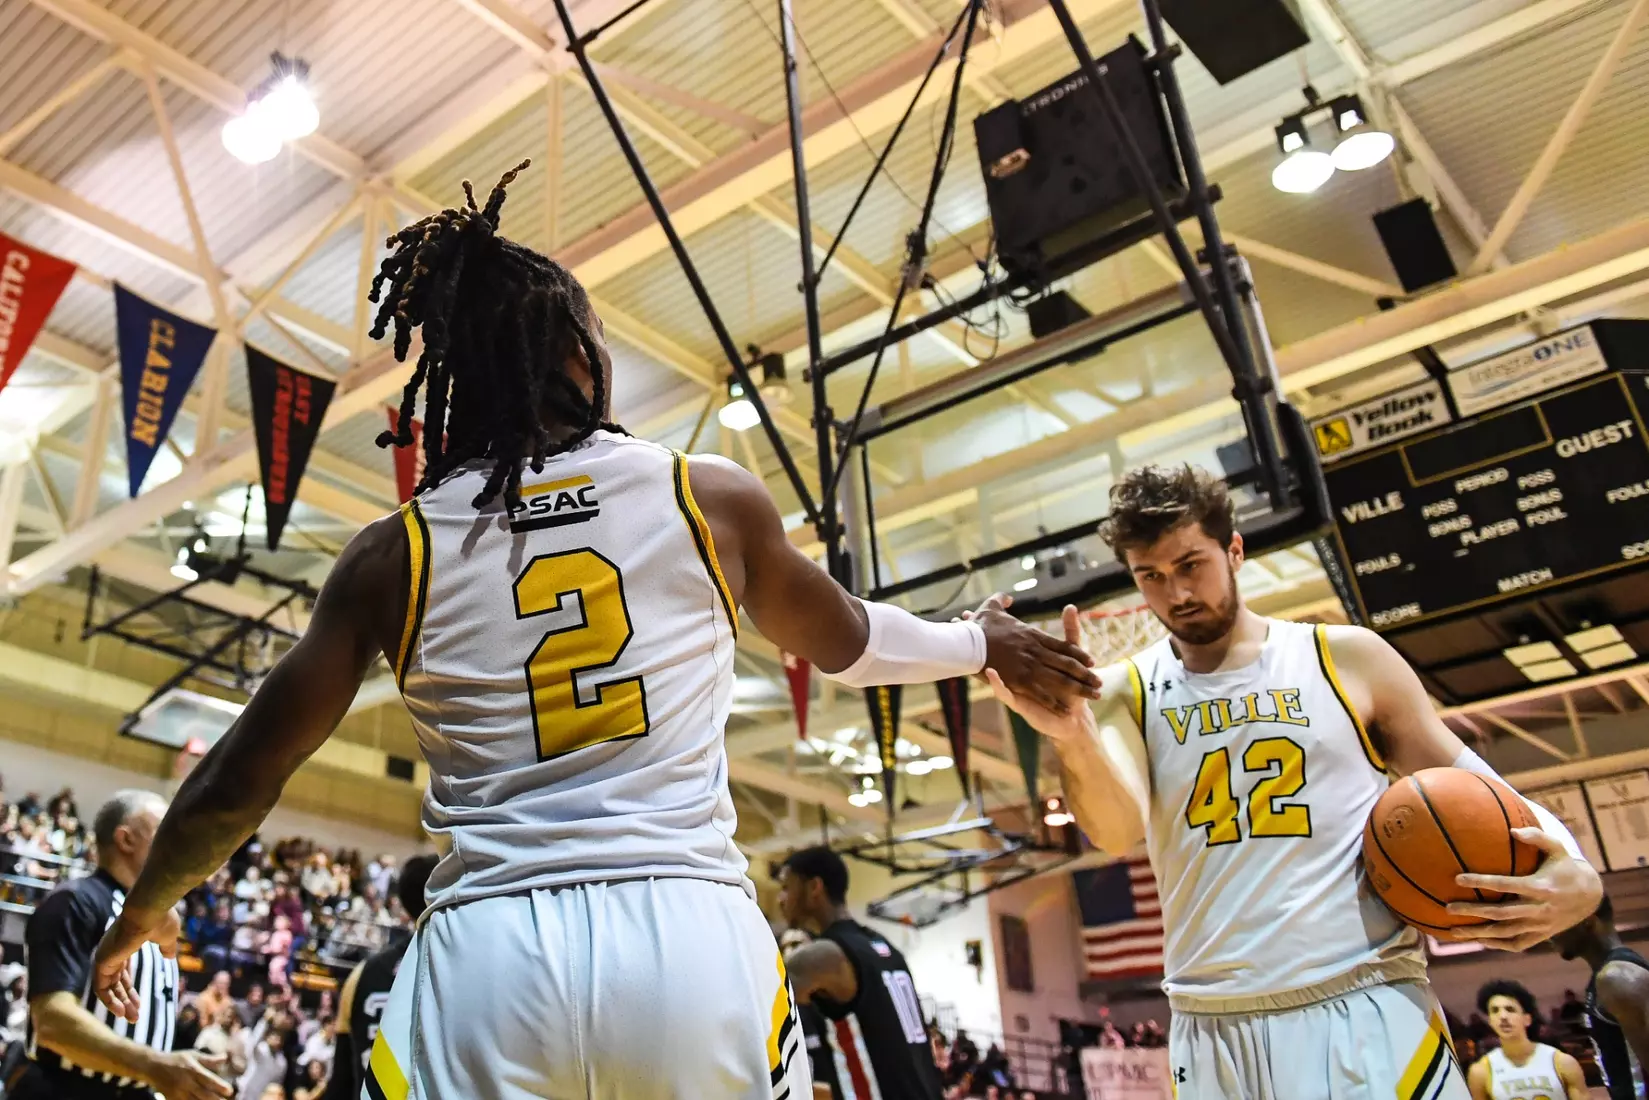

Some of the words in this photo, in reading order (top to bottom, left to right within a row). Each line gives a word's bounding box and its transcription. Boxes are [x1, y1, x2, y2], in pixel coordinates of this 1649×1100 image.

[130, 318, 177, 449] CLARION
[1351, 389, 1437, 427] Yellow
[1368, 409, 1434, 441] Book
[1555, 419, 1634, 458] GUEST
[1454, 466, 1509, 494] PERIOD
[508, 484, 600, 520] PSAC
[1341, 490, 1405, 524] VILLE
[1460, 517, 1521, 546] PLAYER
[1355, 552, 1402, 577] FOULS
[1497, 566, 1553, 592] MATCH
[1371, 601, 1422, 627] SCORE
[511, 546, 650, 763] 2
[1161, 688, 1310, 745] VILLE
[1185, 735, 1312, 847] 42
[881, 969, 928, 1044] 10
